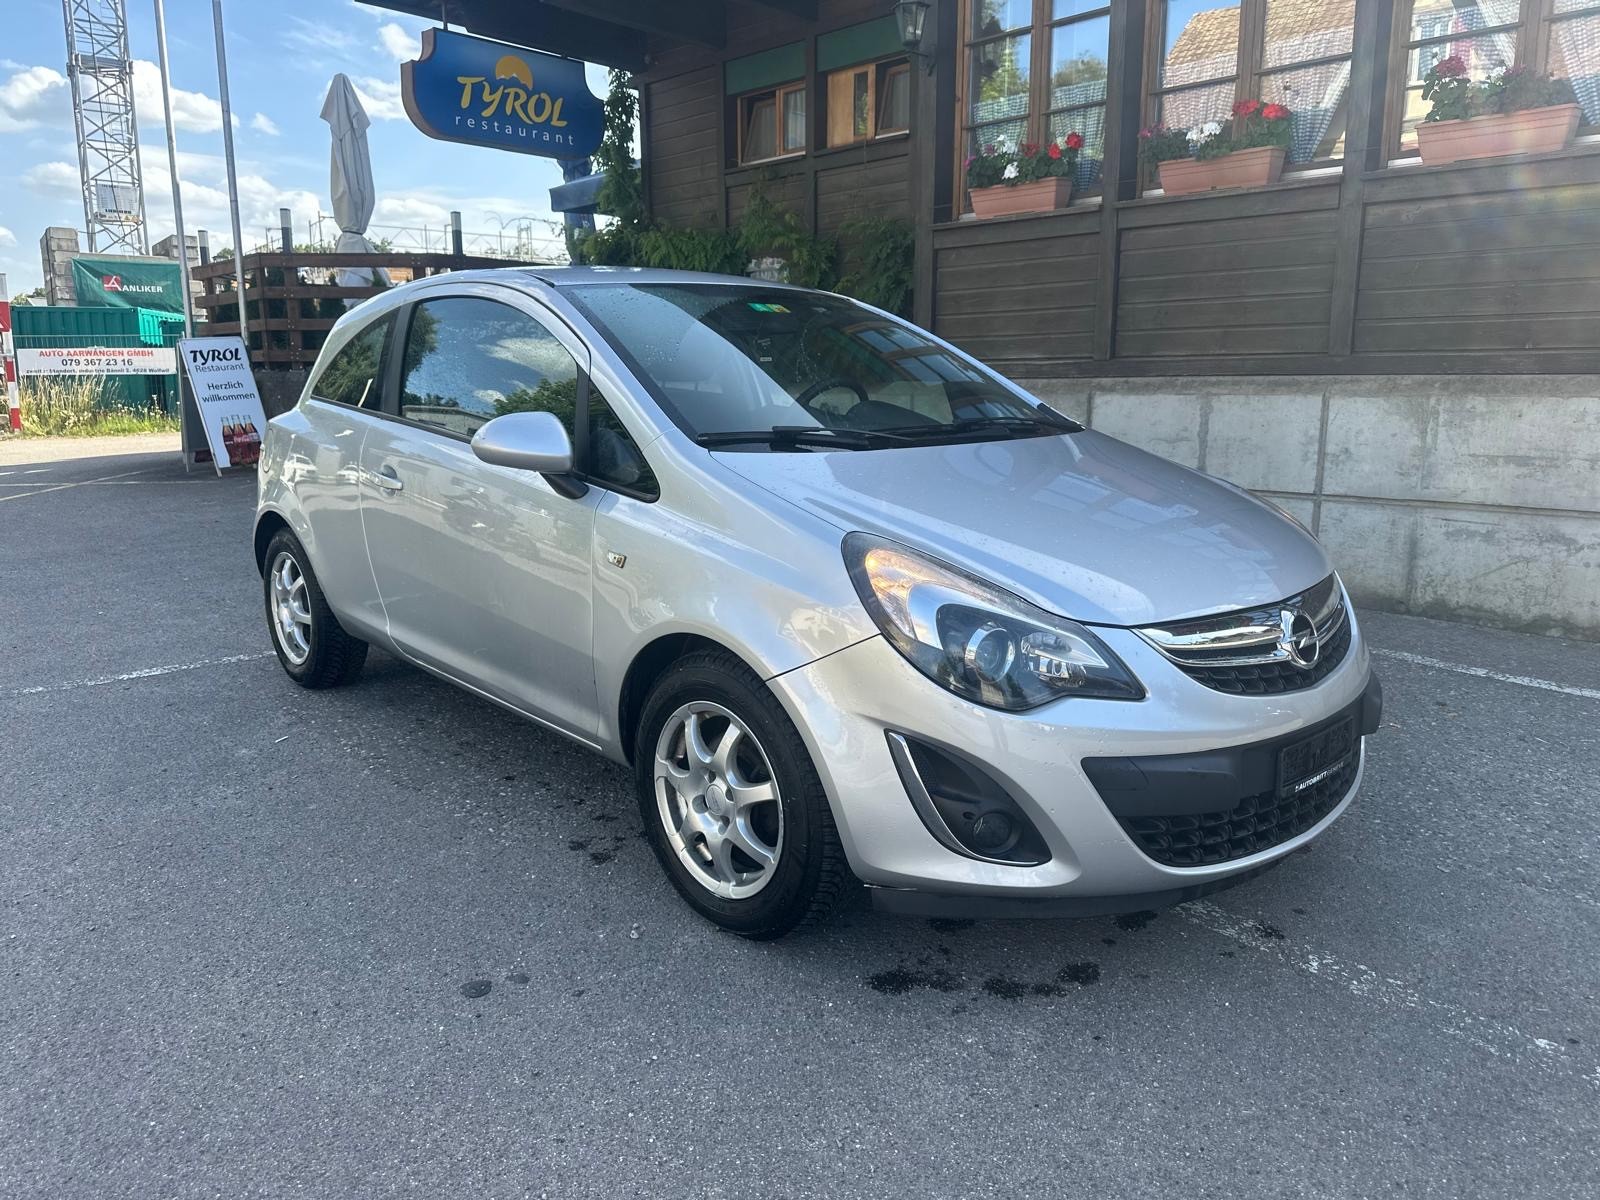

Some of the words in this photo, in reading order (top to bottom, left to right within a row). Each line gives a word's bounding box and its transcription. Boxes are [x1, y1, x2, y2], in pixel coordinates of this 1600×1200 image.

[457, 76, 568, 127] TYROL
[455, 115, 574, 146] restaurant
[39, 350, 64, 358] AUTO
[190, 348, 242, 365] TYROL
[61, 358, 81, 366] 079
[84, 358, 102, 366] 367
[105, 358, 118, 366] 23
[121, 358, 133, 366] 16
[195, 363, 245, 373] Restaurant
[208, 381, 243, 390] Herzlich
[202, 393, 256, 402] willkommen
